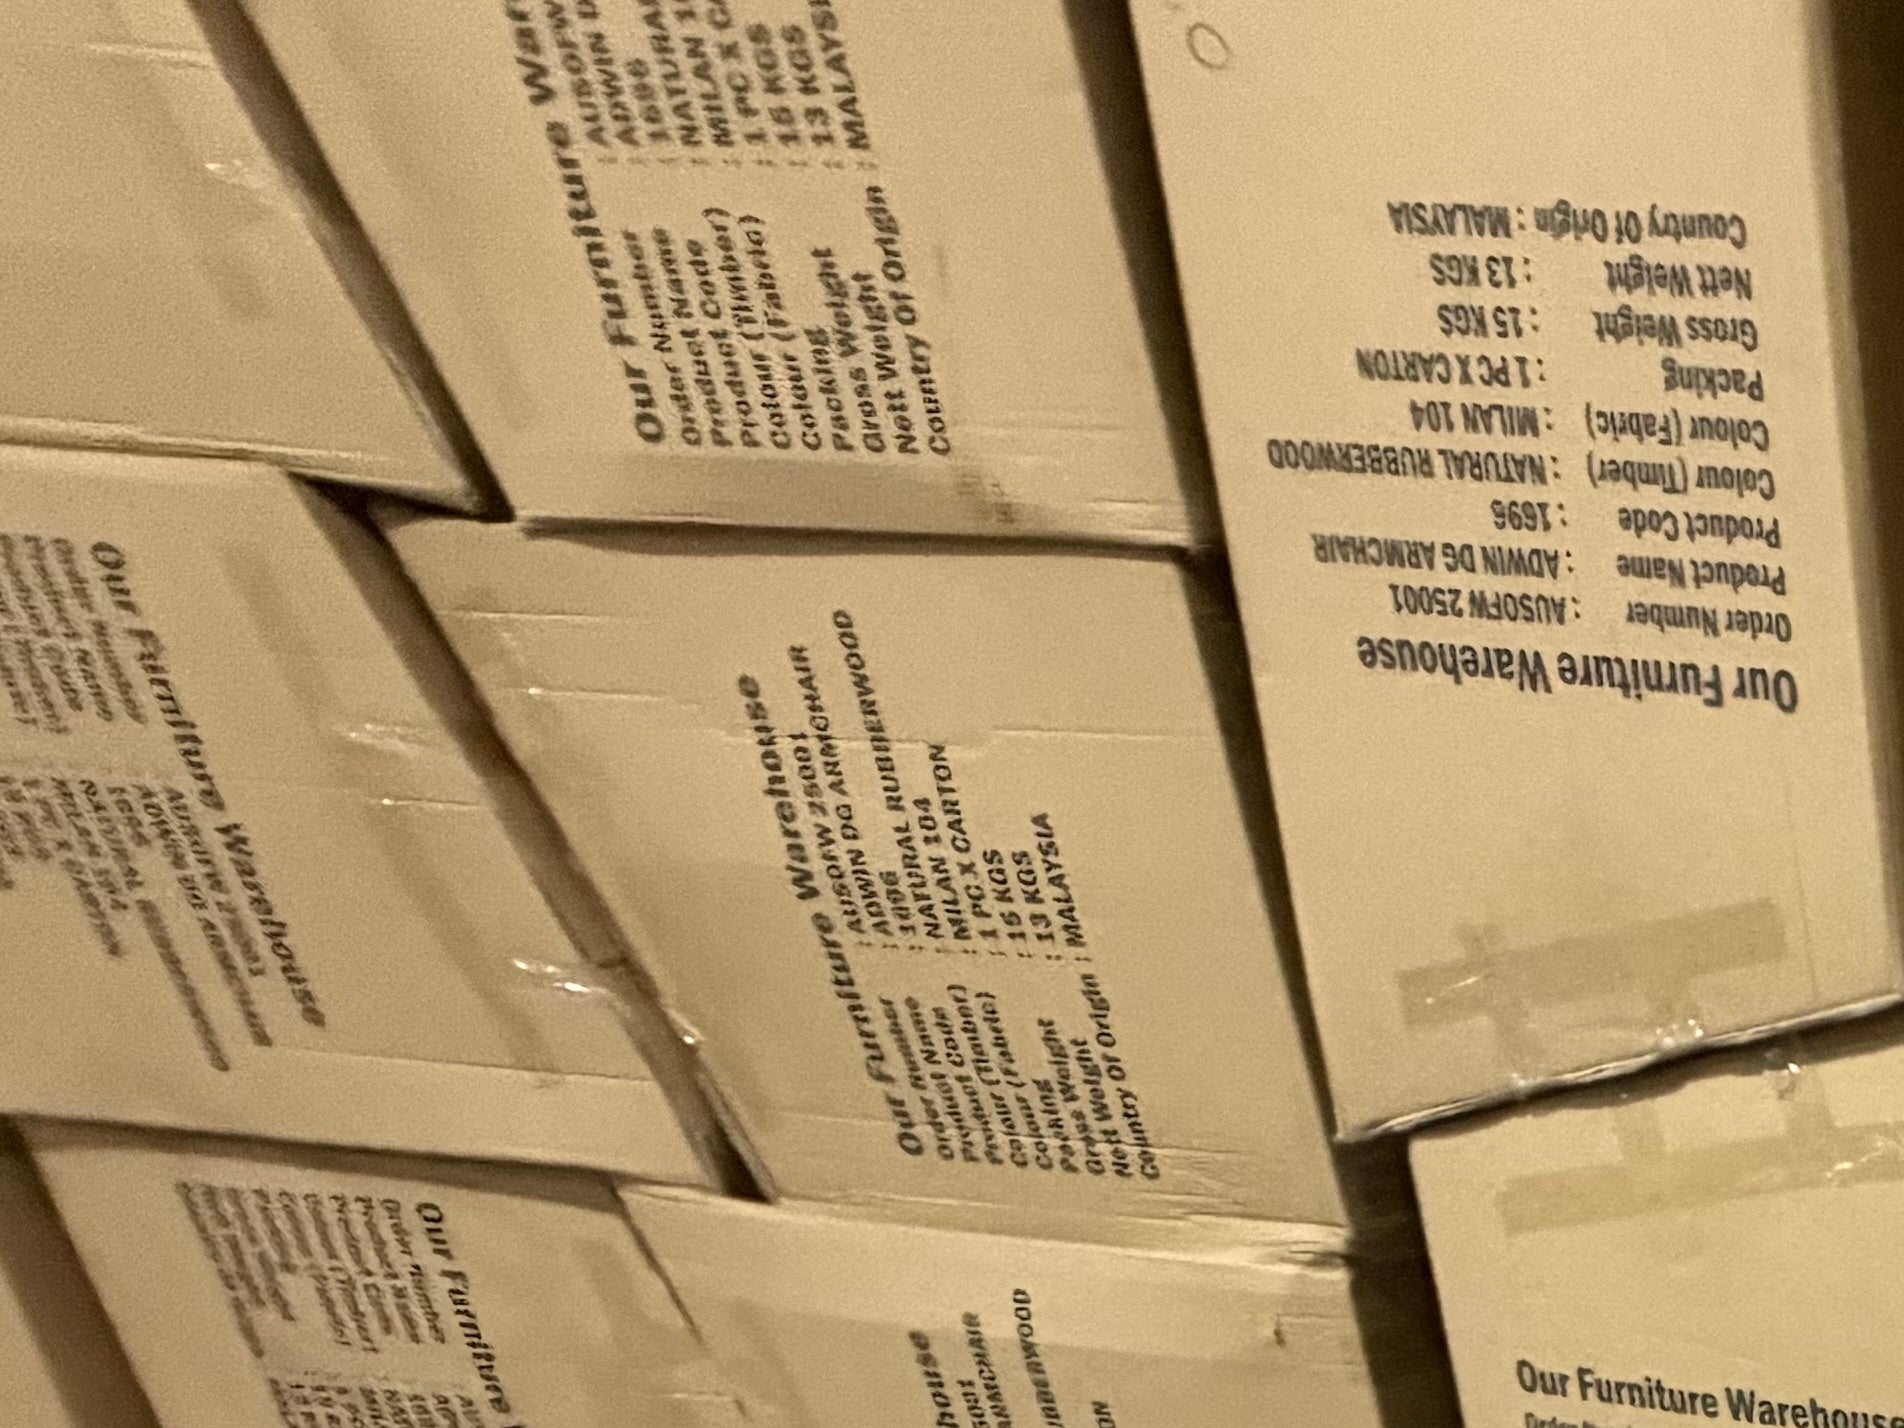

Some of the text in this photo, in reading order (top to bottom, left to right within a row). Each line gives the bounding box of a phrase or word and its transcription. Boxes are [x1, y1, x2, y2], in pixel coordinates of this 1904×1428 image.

[1386, 200, 1747, 249] Country Of Origin MALAYSIA
[1357, 636, 1799, 714] Our Furniture Warehouse
[1516, 1361, 1570, 1397] Our
[1576, 1368, 1719, 1418] Furniture
